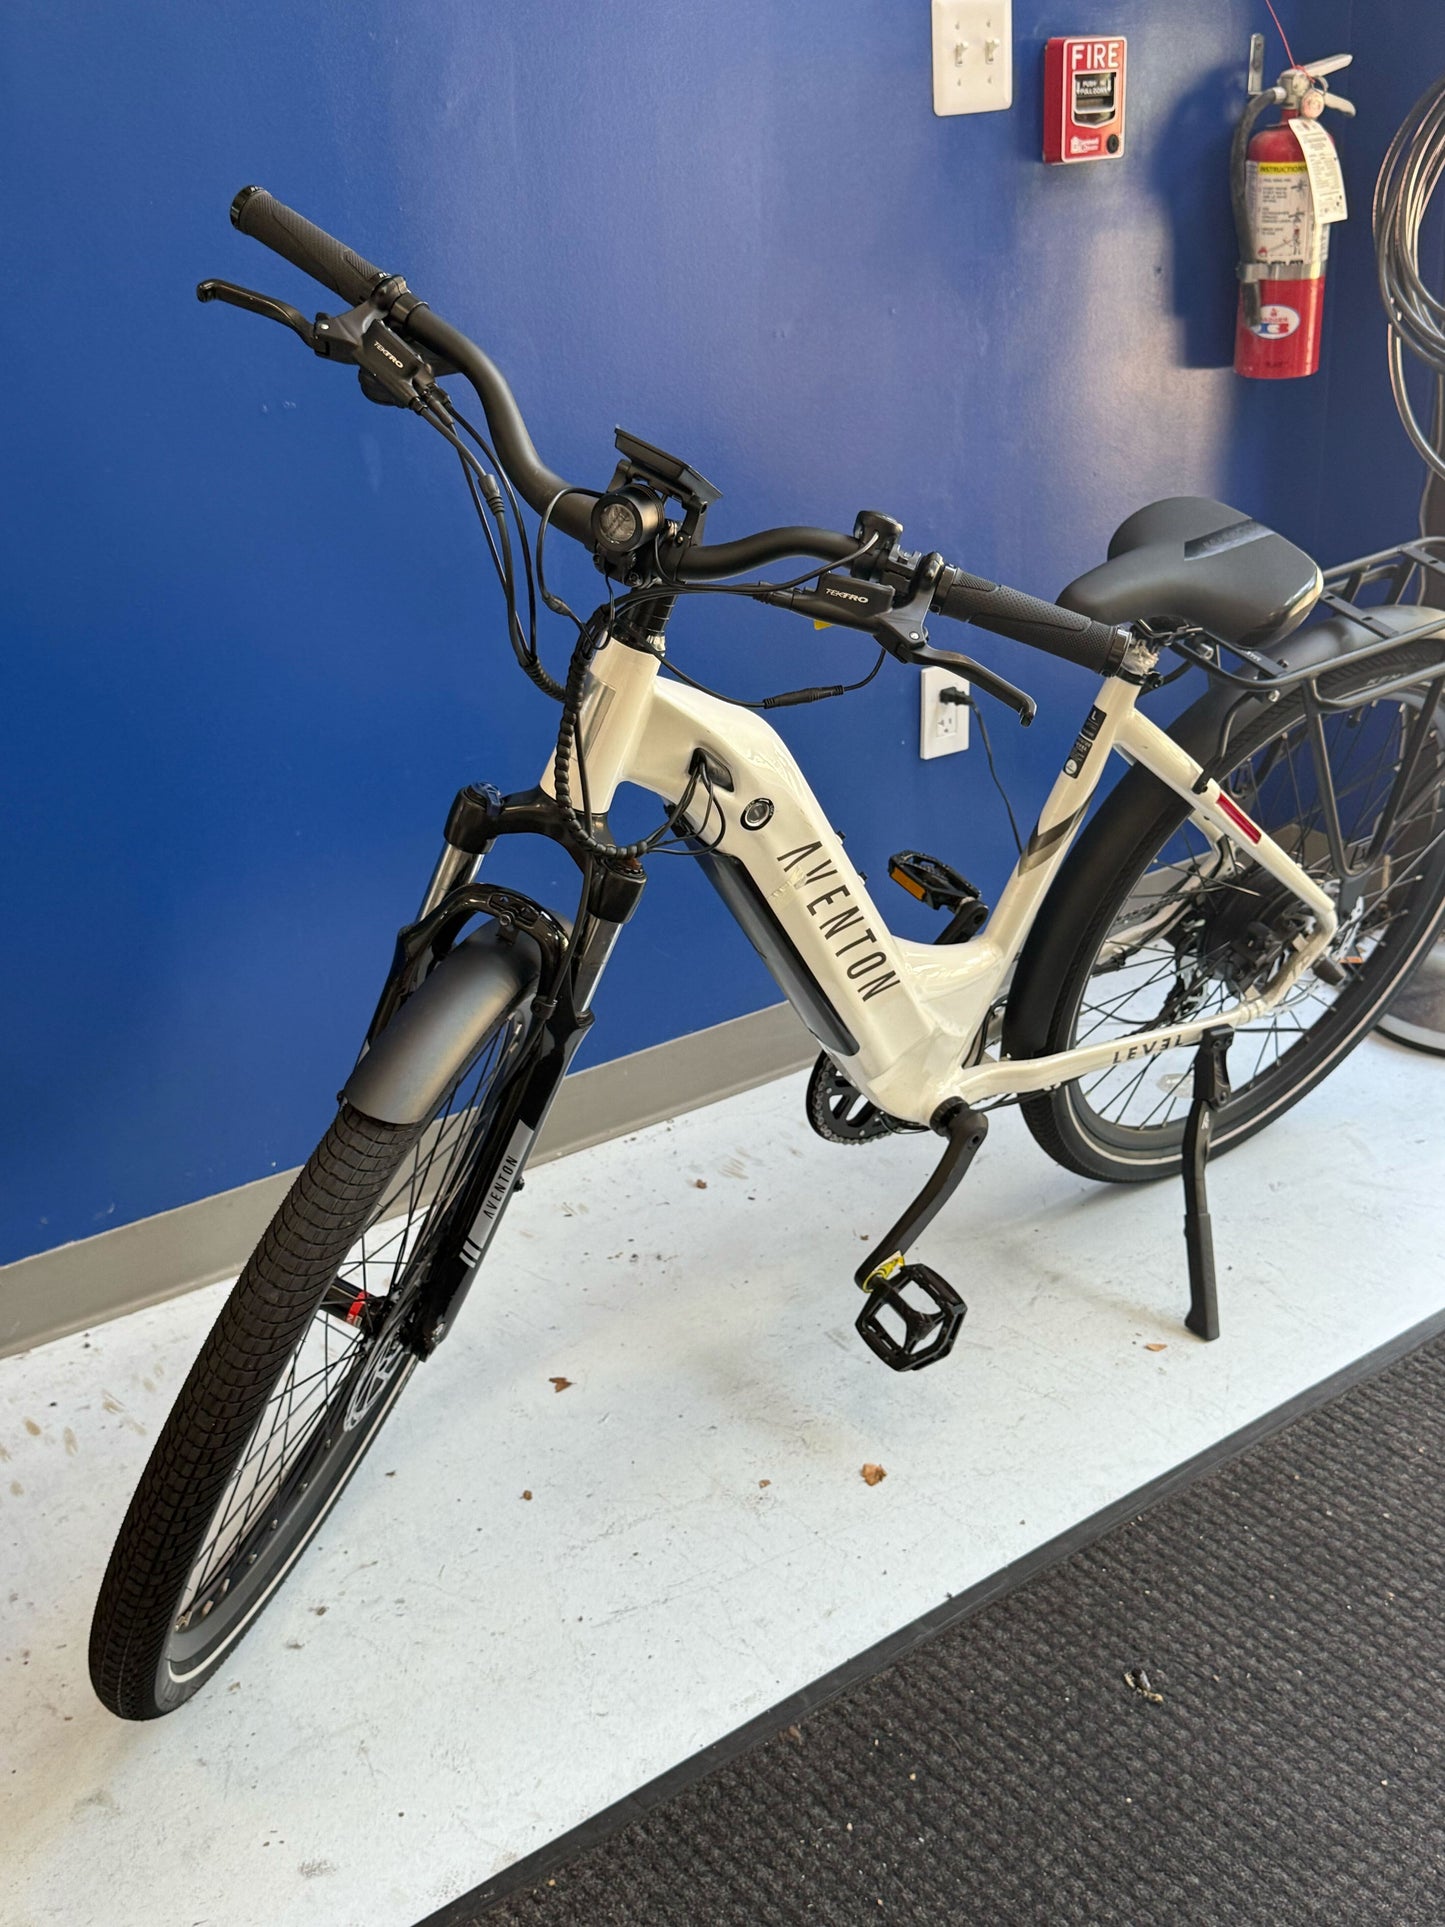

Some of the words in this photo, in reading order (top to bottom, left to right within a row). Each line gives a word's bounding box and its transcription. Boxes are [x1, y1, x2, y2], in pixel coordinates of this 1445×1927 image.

[1072, 42, 1119, 70] FIRE
[374, 341, 404, 368] TEKTRO
[826, 588, 869, 603] TEKTRO
[777, 840, 901, 1002] AVENTON
[1112, 1034, 1182, 1065] LEVEL
[483, 1155, 518, 1220] AVENTON
